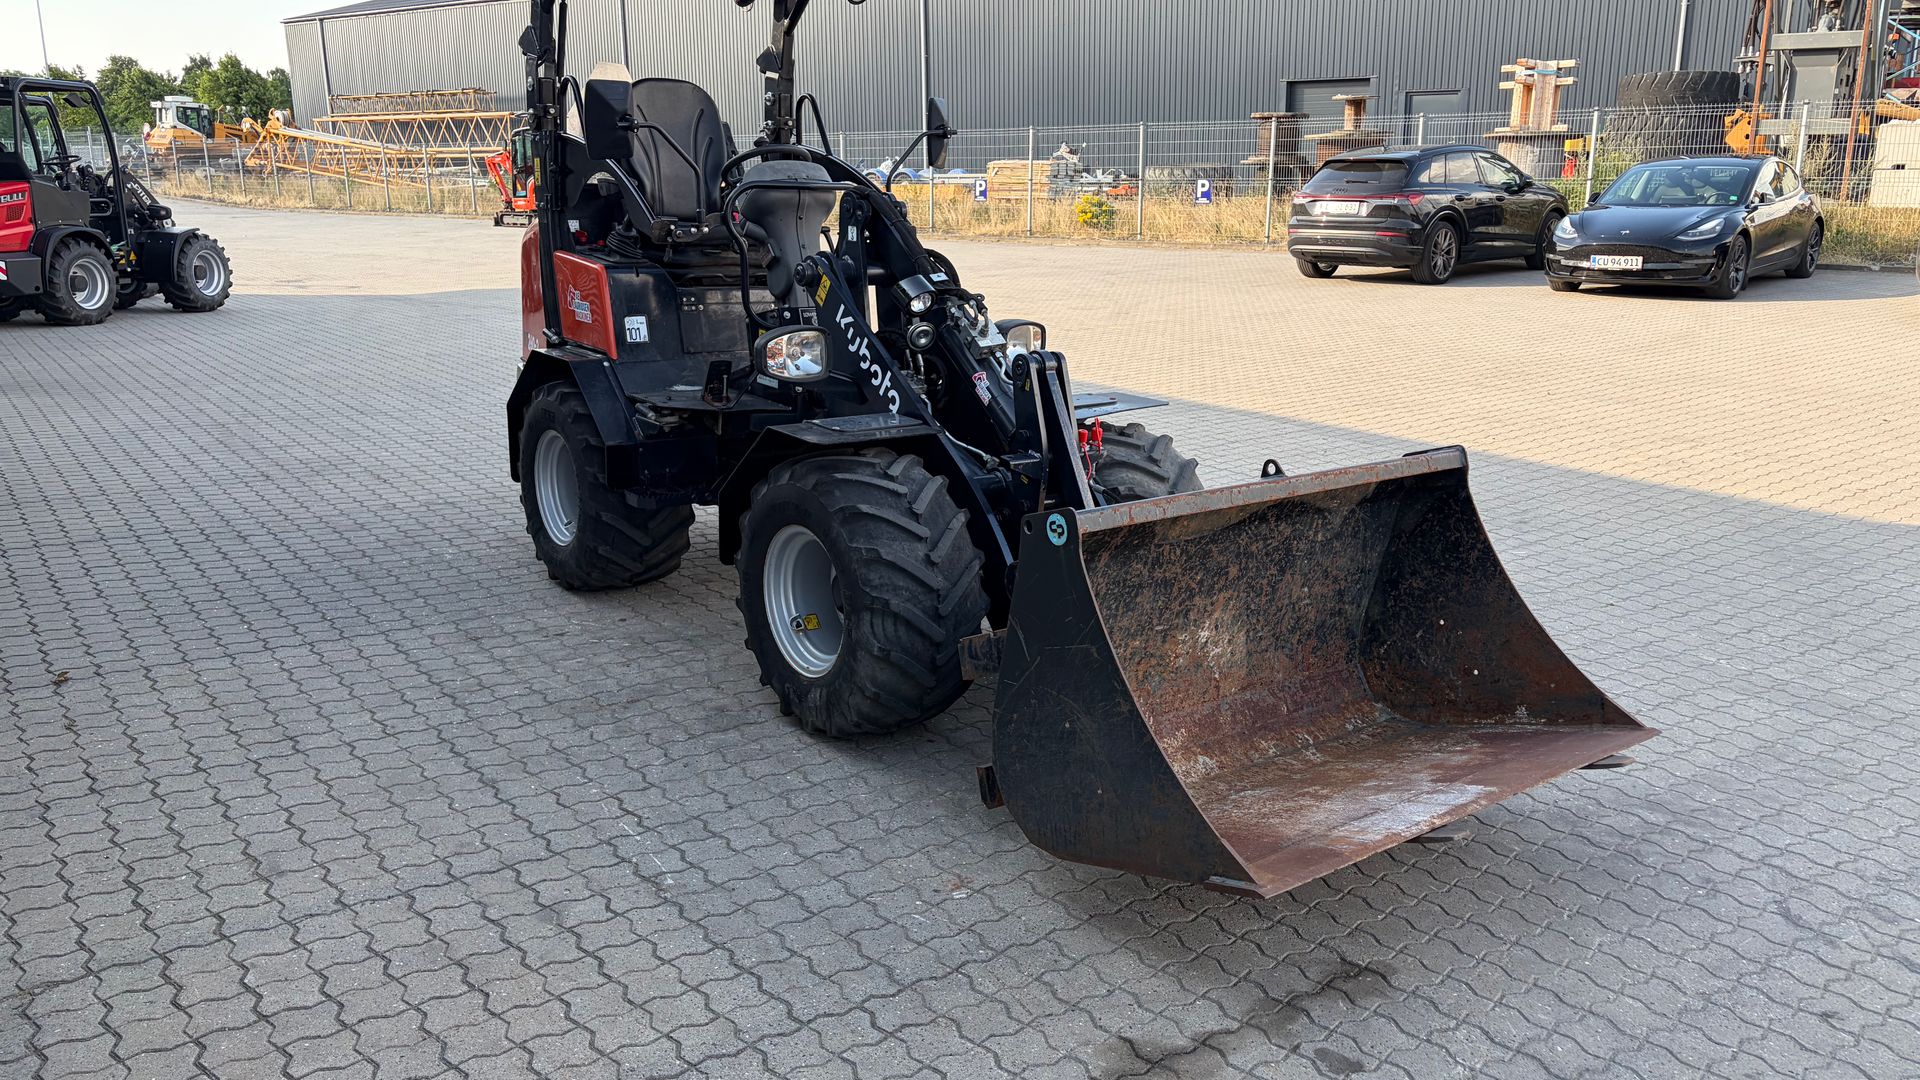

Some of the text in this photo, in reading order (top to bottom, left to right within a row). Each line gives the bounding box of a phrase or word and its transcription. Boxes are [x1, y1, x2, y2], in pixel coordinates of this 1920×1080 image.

[976, 180, 986, 196] P
[1197, 180, 1210, 198] P
[0, 192, 25, 202] BULL
[626, 327, 641, 341] 101
[835, 303, 900, 414] Kubota
